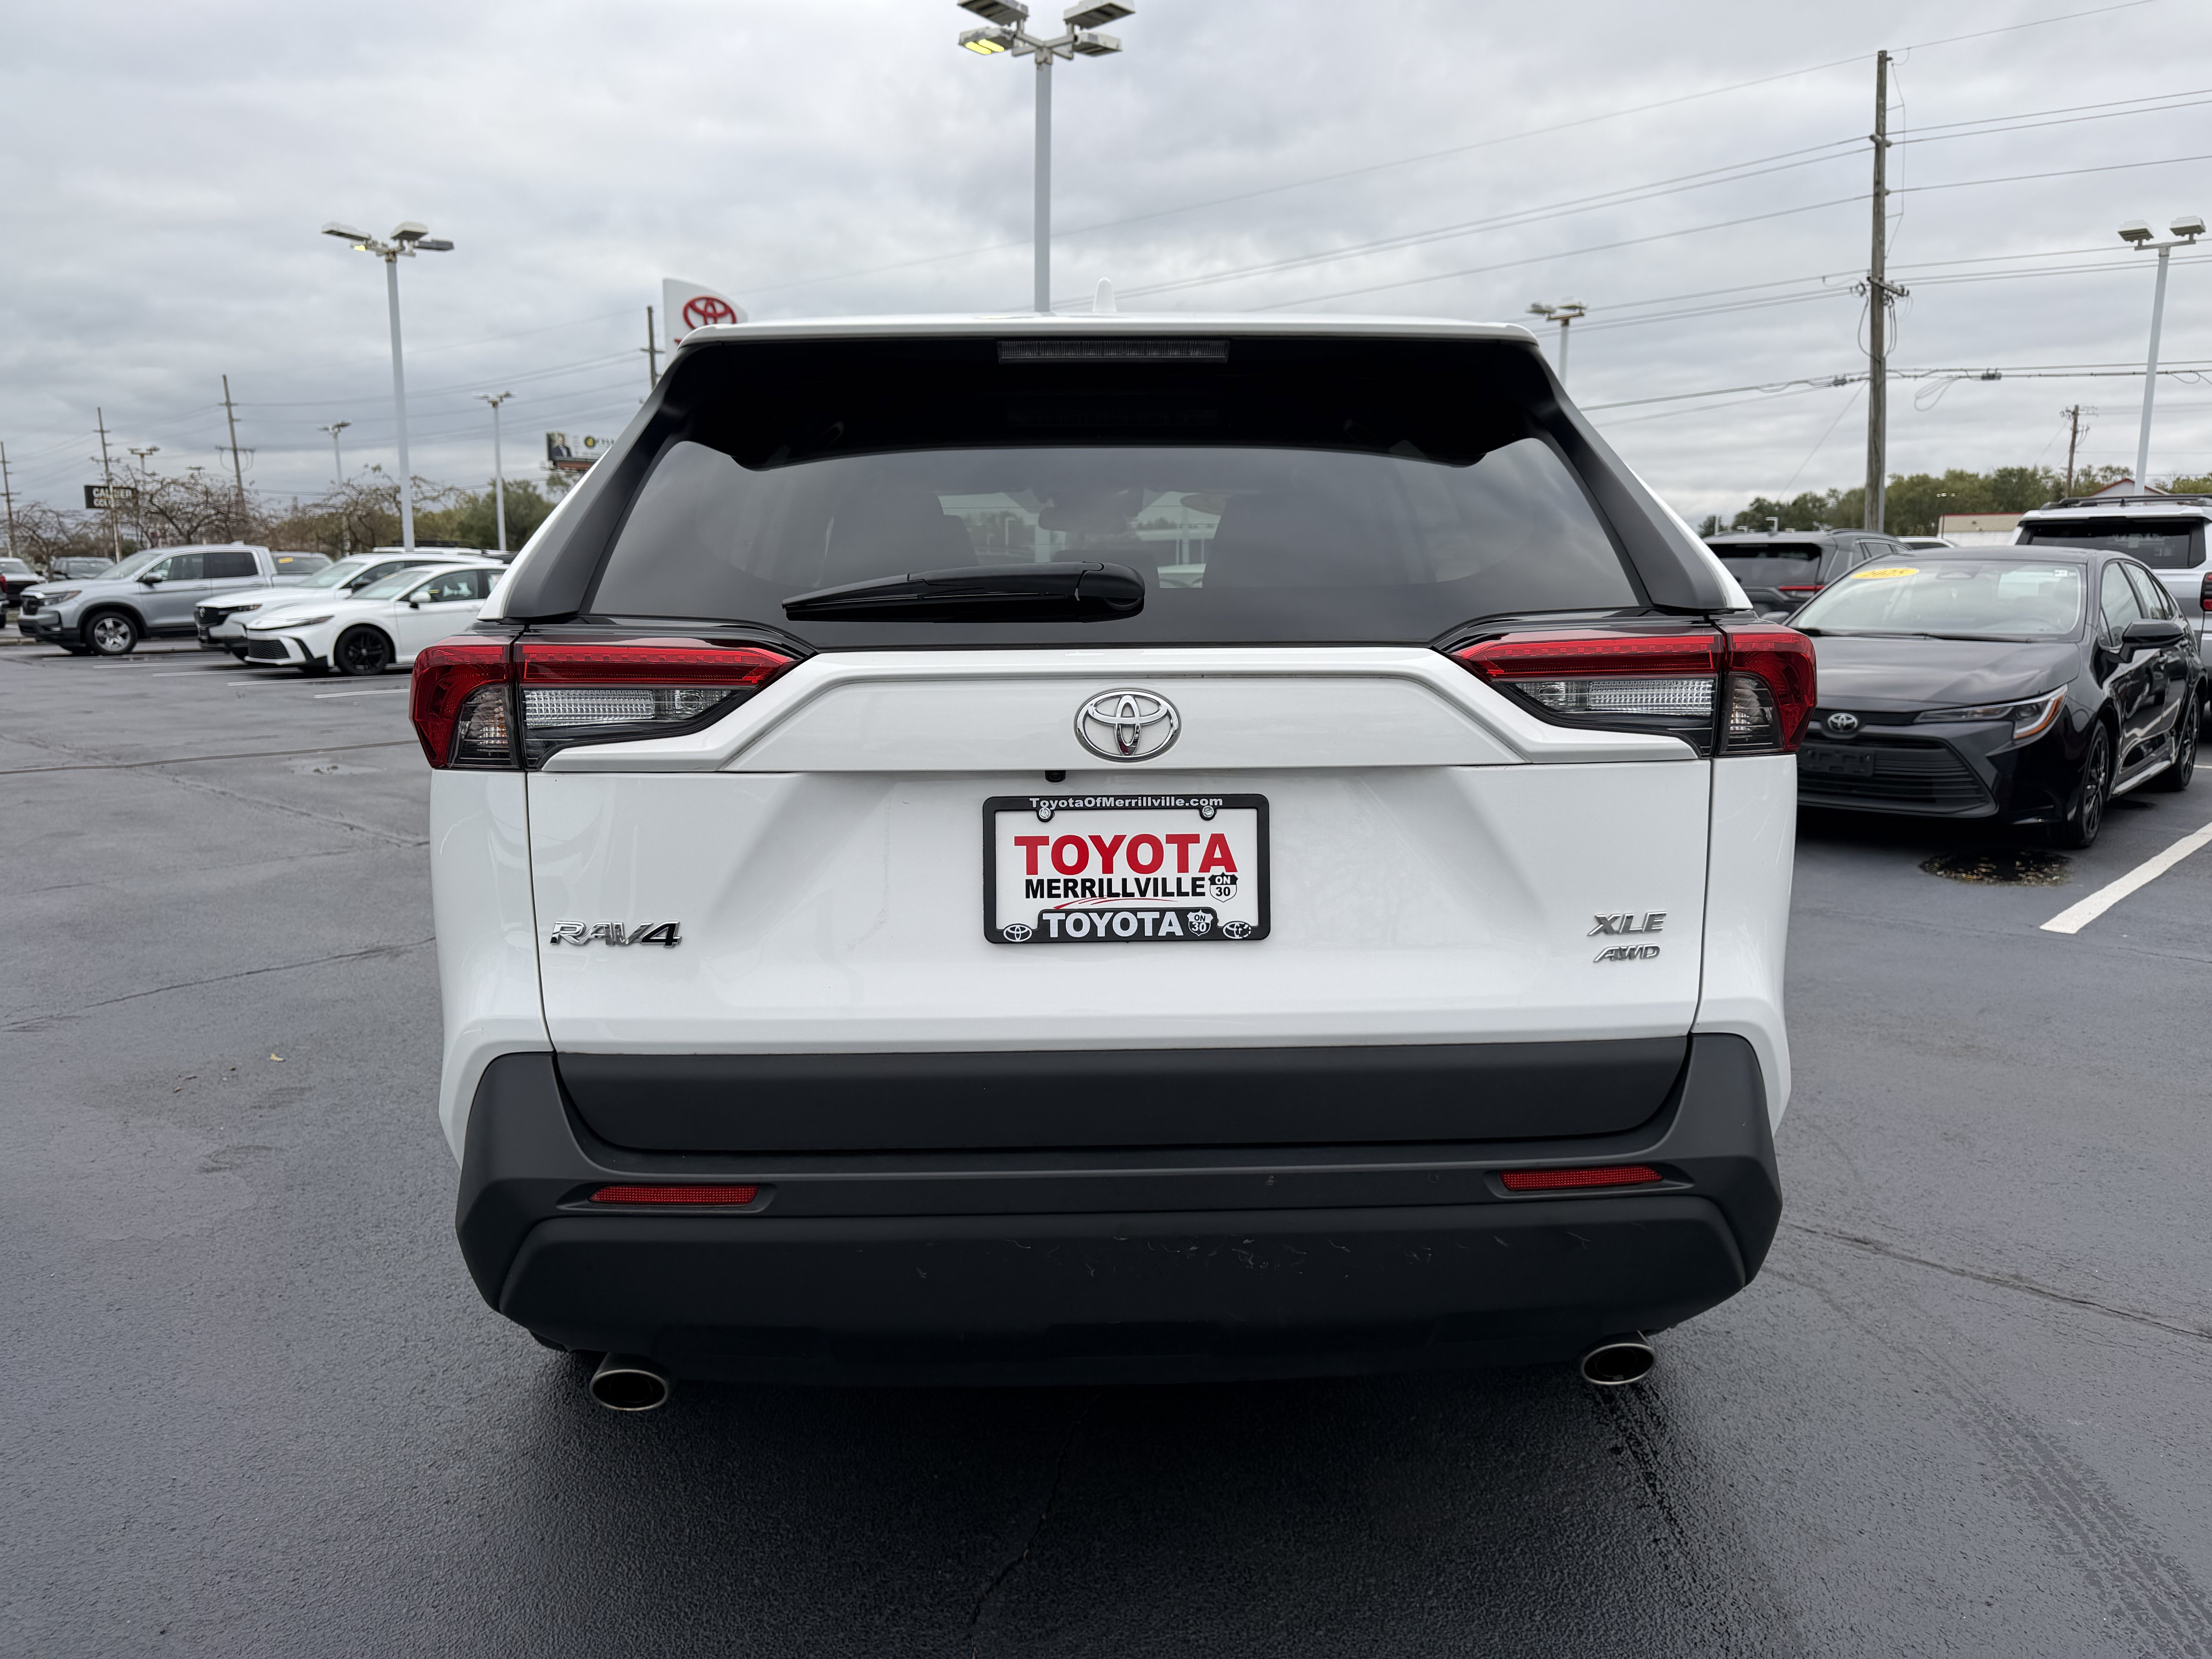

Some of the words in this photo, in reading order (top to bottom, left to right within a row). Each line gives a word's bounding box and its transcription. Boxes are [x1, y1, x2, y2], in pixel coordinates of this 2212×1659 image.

[93, 488, 132, 499] CALBER
[1029, 797, 1223, 810] ToyotaOfMerrillville.com
[1014, 833, 1238, 876] TOYOTA
[1025, 876, 1206, 898] MERRILLVILLE
[1215, 876, 1231, 884] ON
[1215, 886, 1231, 896] 30
[1042, 911, 1183, 938] TOYOTA
[1191, 922, 1207, 932] 30
[1587, 911, 1667, 936] XLE
[550, 920, 682, 948] RAV4
[1593, 944, 1660, 963] AWD
